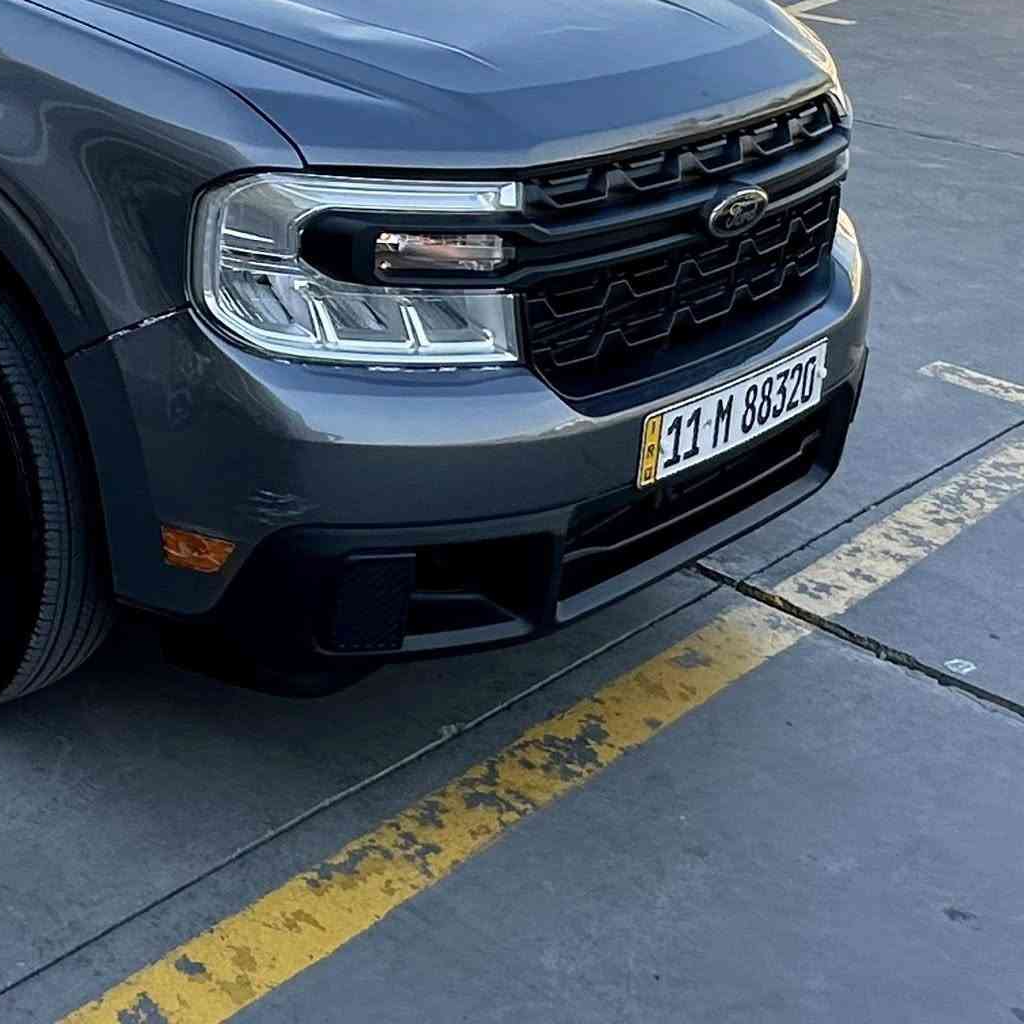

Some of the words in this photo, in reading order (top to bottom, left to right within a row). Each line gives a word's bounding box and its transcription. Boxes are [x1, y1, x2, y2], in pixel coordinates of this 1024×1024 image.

[725, 198, 764, 229] Ford
[663, 407, 702, 468] 11
[712, 394, 734, 448] M
[741, 356, 817, 434] 88320
